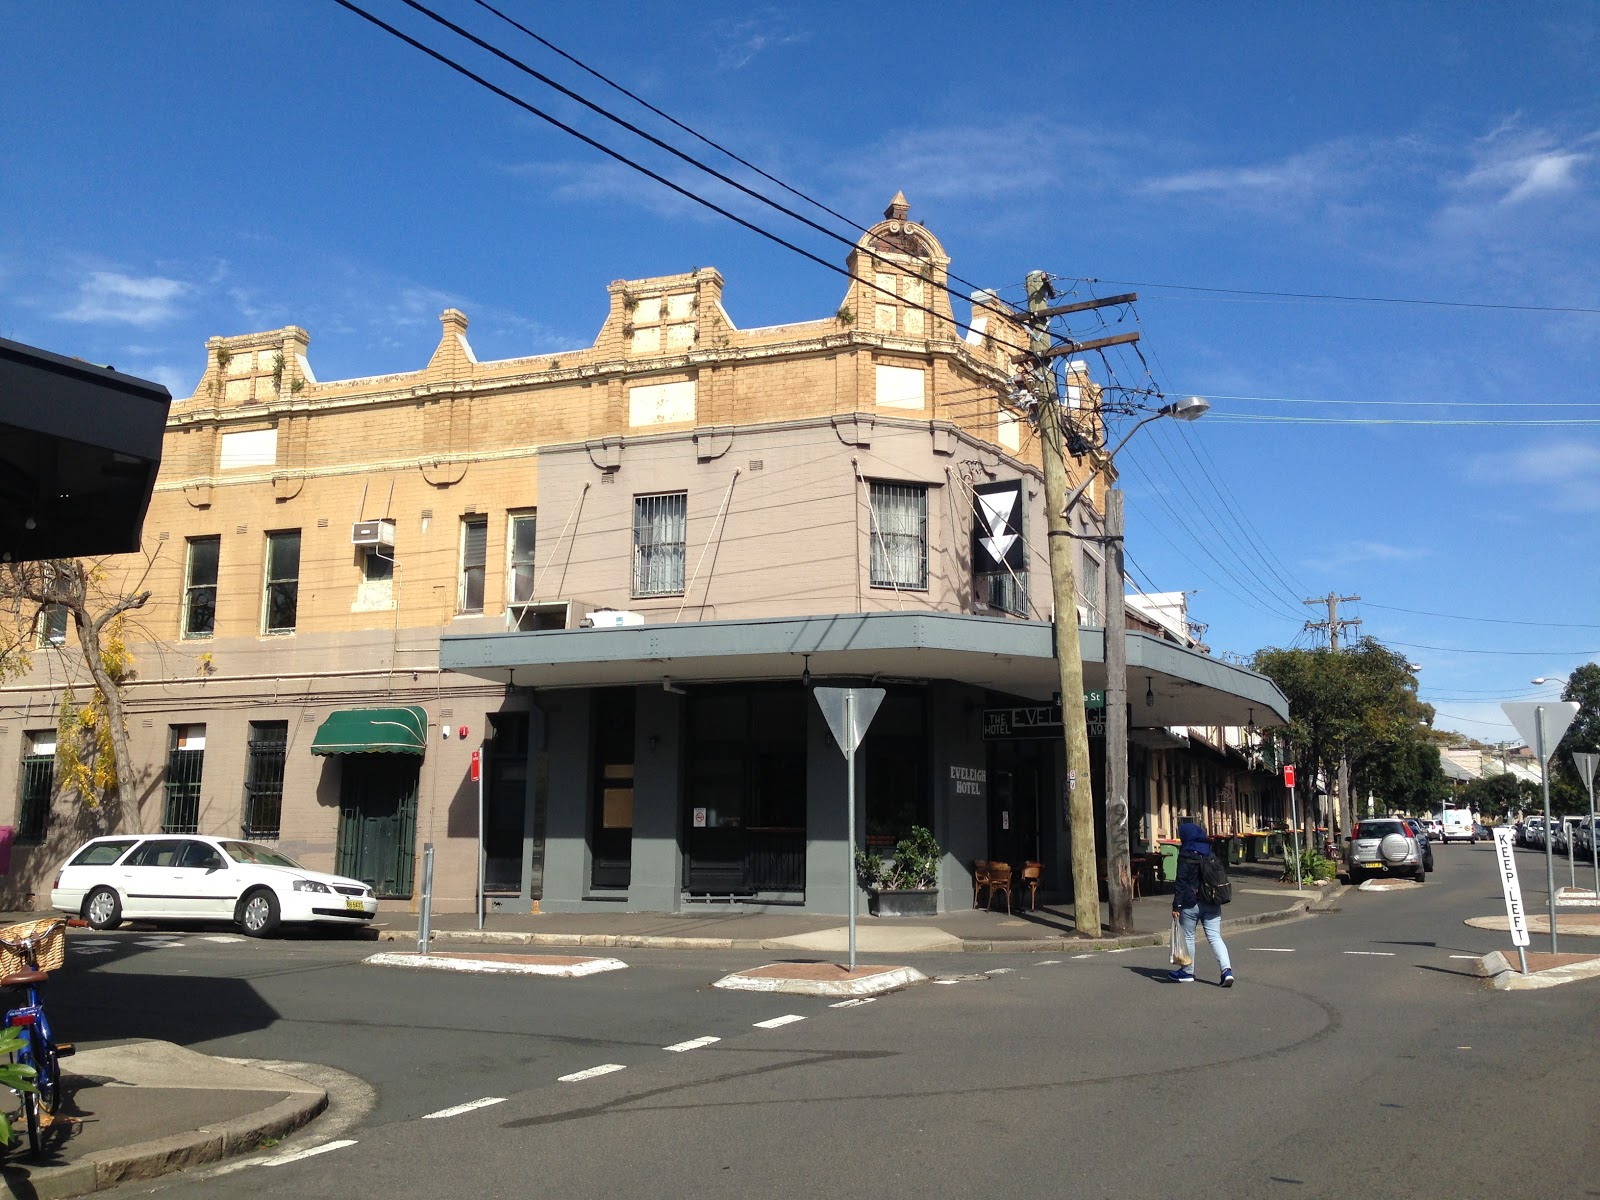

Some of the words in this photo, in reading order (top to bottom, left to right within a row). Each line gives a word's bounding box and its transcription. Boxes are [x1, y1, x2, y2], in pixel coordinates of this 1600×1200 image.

[1090, 692, 1100, 701] St
[989, 714, 1006, 724] THE
[1012, 707, 1107, 727] EVELGH
[985, 725, 1011, 735] HOTEL
[950, 766, 986, 782] EVELEIGH
[956, 781, 980, 795] HOTEL
[1499, 834, 1514, 883] KEEP
[1509, 890, 1523, 942] LEFT
